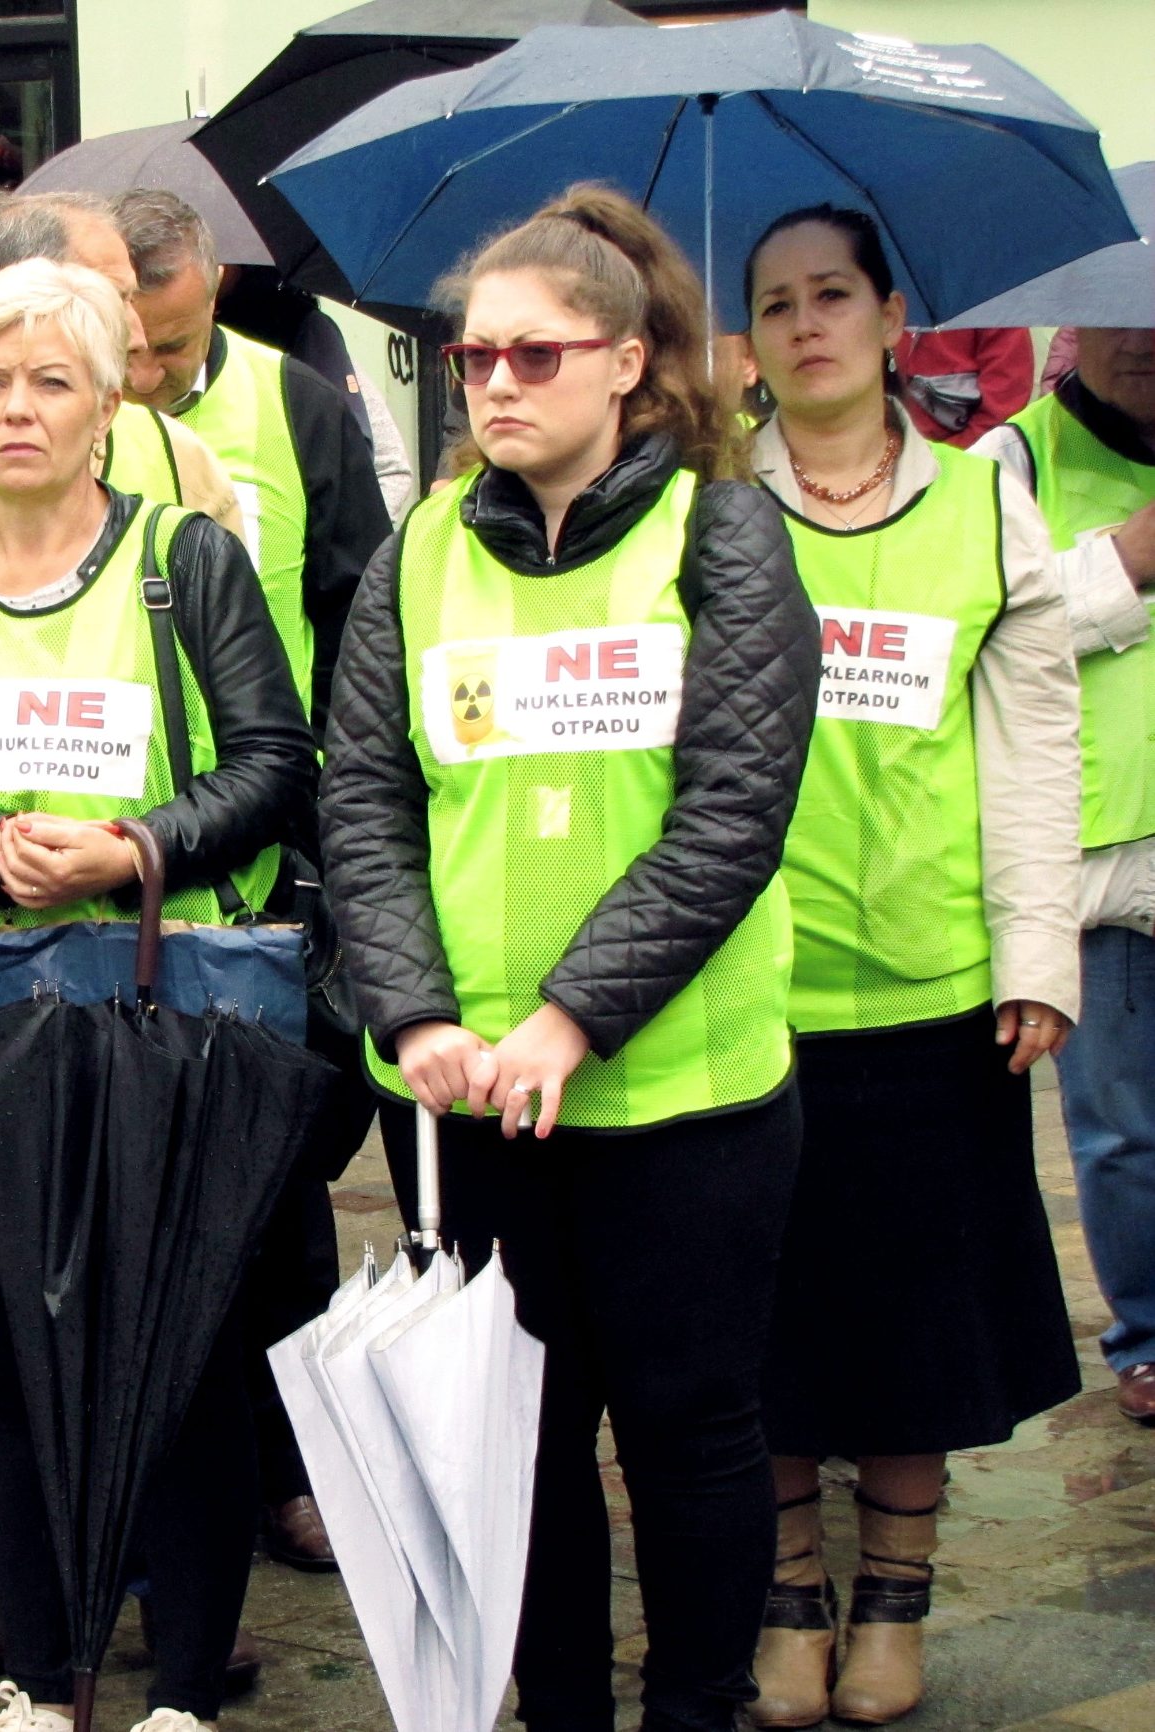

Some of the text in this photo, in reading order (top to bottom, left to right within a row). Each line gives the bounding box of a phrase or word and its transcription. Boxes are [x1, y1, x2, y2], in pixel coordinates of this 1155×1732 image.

[821, 618, 908, 661] NE
[545, 638, 640, 683] NE
[820, 665, 930, 690] KLEARNOM
[16, 691, 106, 729] NE
[515, 690, 668, 711] NUKLEARNOM
[822, 690, 900, 709] OTPADU
[551, 718, 641, 736] OTPADU
[18, 761, 100, 780] OTPADU
